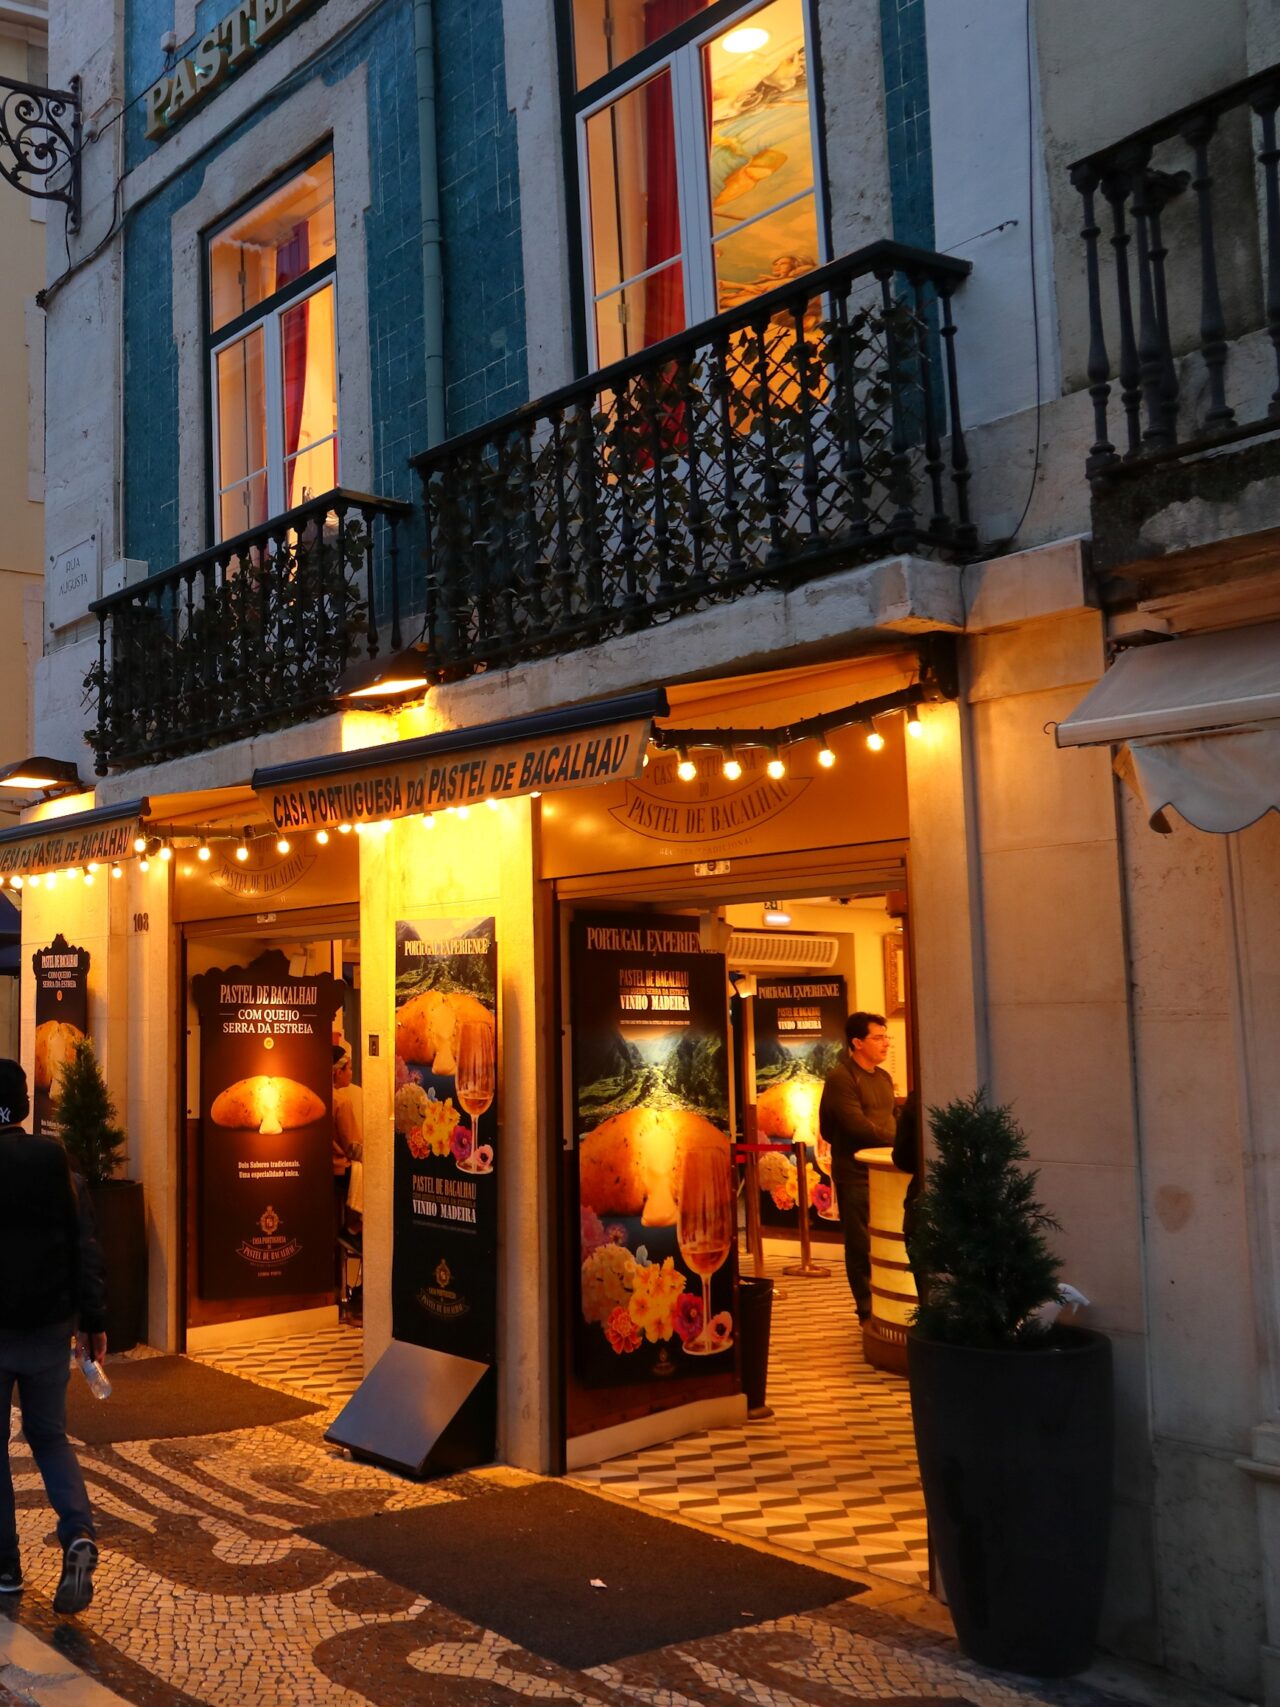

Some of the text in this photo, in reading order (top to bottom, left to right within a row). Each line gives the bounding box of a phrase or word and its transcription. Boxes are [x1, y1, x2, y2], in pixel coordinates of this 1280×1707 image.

[144, 0, 320, 139] PASTE
[65, 557, 81, 573] RUA
[58, 573, 88, 597] AUGUSTA
[273, 734, 630, 828] CASA PORTUGUESA DO PASTEL DE BACALHAU
[627, 782, 791, 834] PASTEL DE BACALHAU
[31, 838, 64, 867] PASTEL
[66, 841, 79, 862] DE
[80, 825, 132, 858] BACALHAU
[133, 912, 149, 932] 108
[441, 938, 488, 955] EXPERIENCE
[587, 927, 644, 951] PORTUGAL
[619, 969, 689, 987] PASTEL DE BACALHAU
[220, 985, 317, 1005] PASTEL DE BACALHAU
[793, 984, 839, 1000] EXPERIENCE
[620, 995, 690, 1010] VINHO MADEIRA
[238, 1009, 299, 1022] COM QUEIJO
[223, 1022, 255, 1033] SERRA
[257, 1023, 272, 1034] DA
[238, 1160, 300, 1169] Dois Sabores tradicionais.
[251, 1170, 284, 1179] especialidade
[285, 1169, 299, 1177] única.
[412, 1174, 477, 1200] PASTEL DE BACALHAU
[412, 1199, 477, 1223] VINHO MADEIRA
